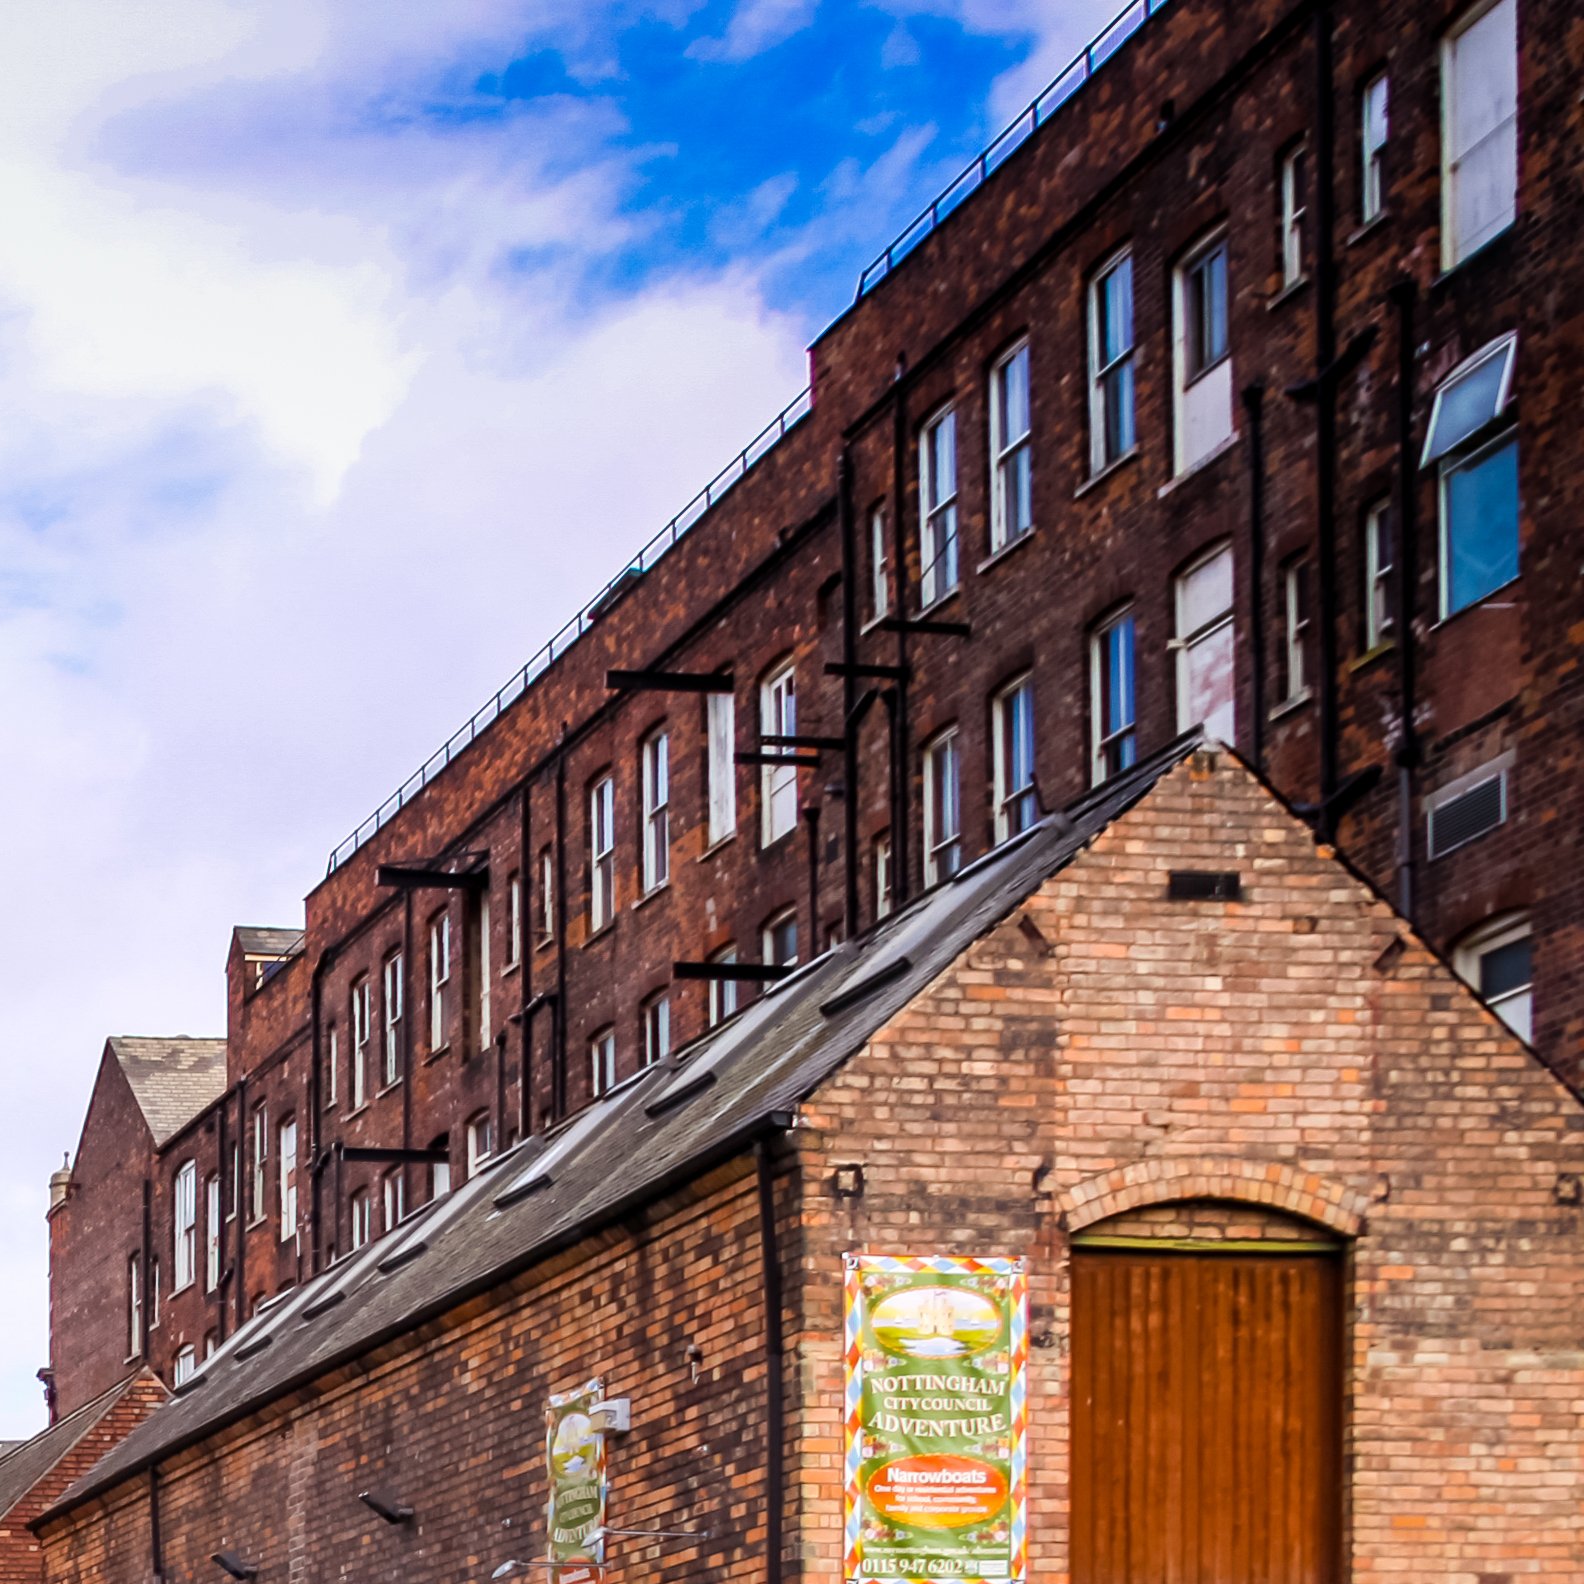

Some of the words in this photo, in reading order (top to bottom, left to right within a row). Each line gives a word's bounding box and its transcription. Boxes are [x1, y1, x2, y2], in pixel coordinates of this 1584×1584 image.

[870, 1375, 1007, 1396] NOTTINGHAM
[883, 1397, 921, 1412] CITY
[922, 1397, 992, 1412] COUNCIL
[868, 1412, 1006, 1438] ADVENTURE
[887, 1467, 987, 1484] Narrowboats
[862, 1558, 897, 1574] 0115
[899, 1558, 926, 1574] 947
[927, 1558, 963, 1574] 6202
